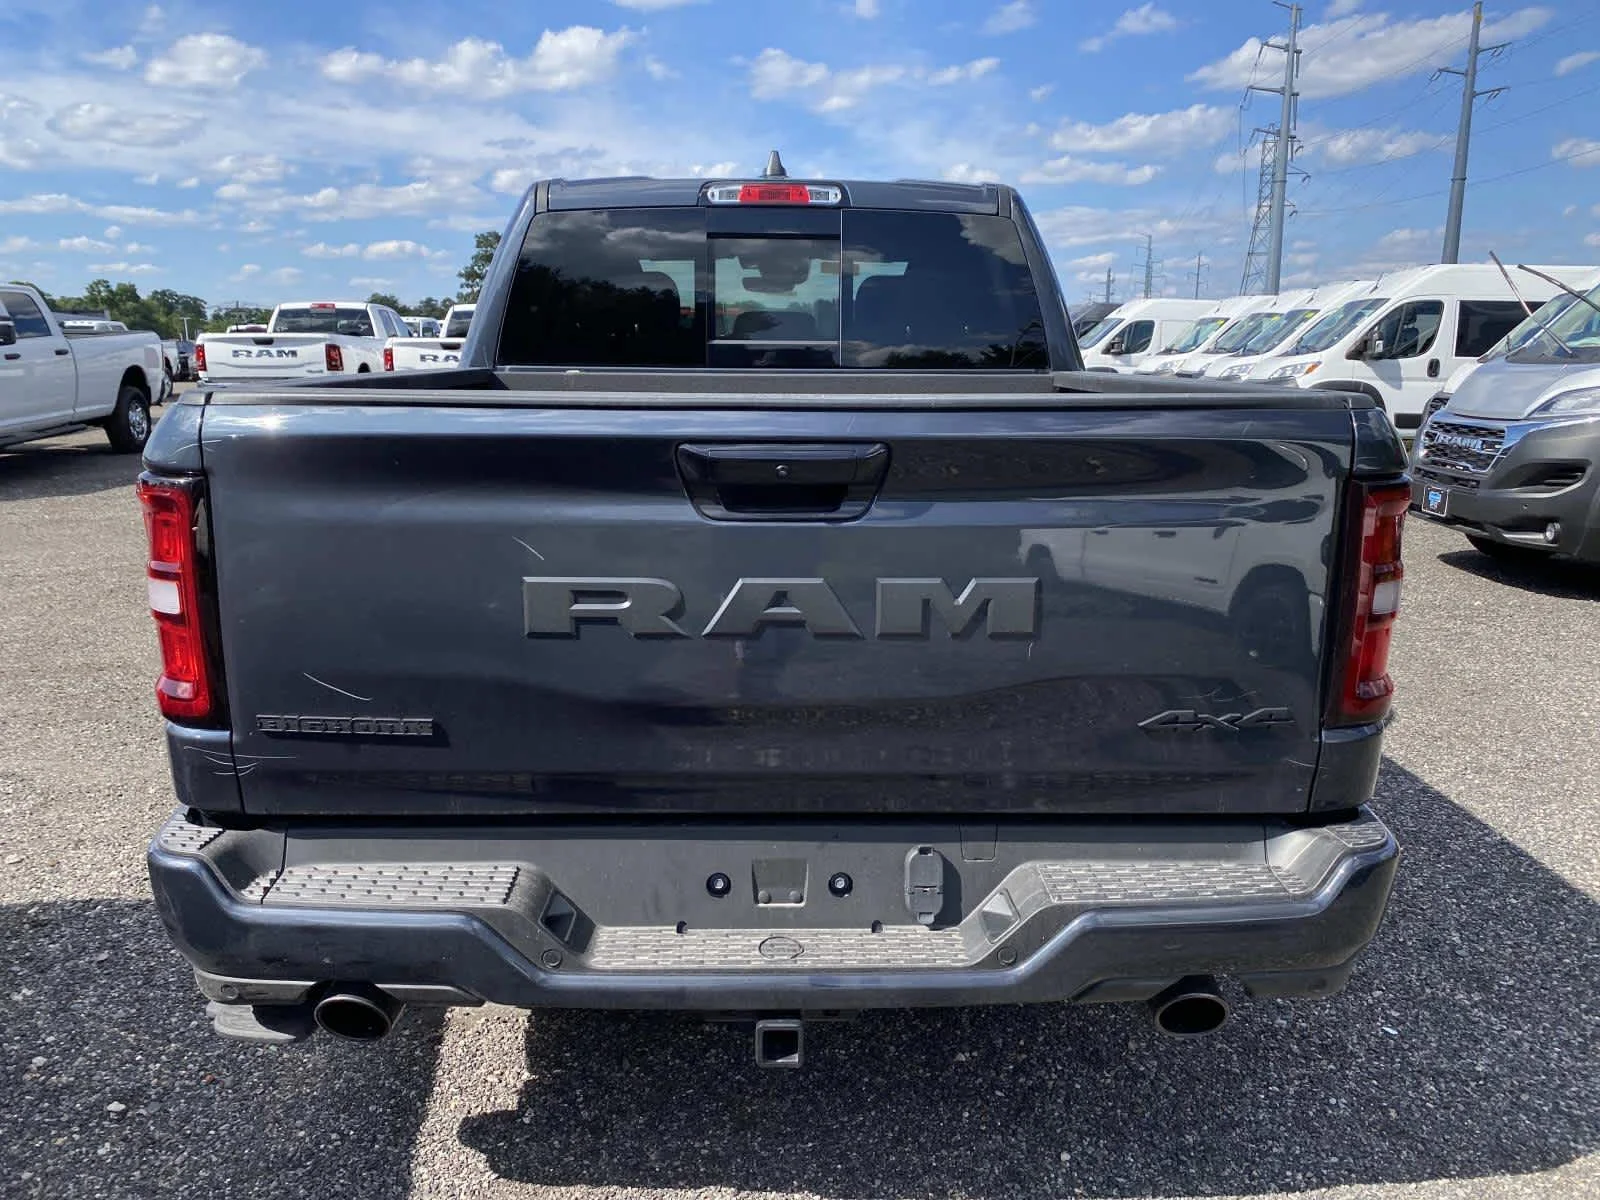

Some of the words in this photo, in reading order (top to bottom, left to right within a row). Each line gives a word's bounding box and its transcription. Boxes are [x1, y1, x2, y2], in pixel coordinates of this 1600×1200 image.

[232, 350, 298, 358] RAM
[420, 354, 460, 362] RA
[1435, 433, 1483, 451] RAM
[522, 576, 1042, 640] RAM
